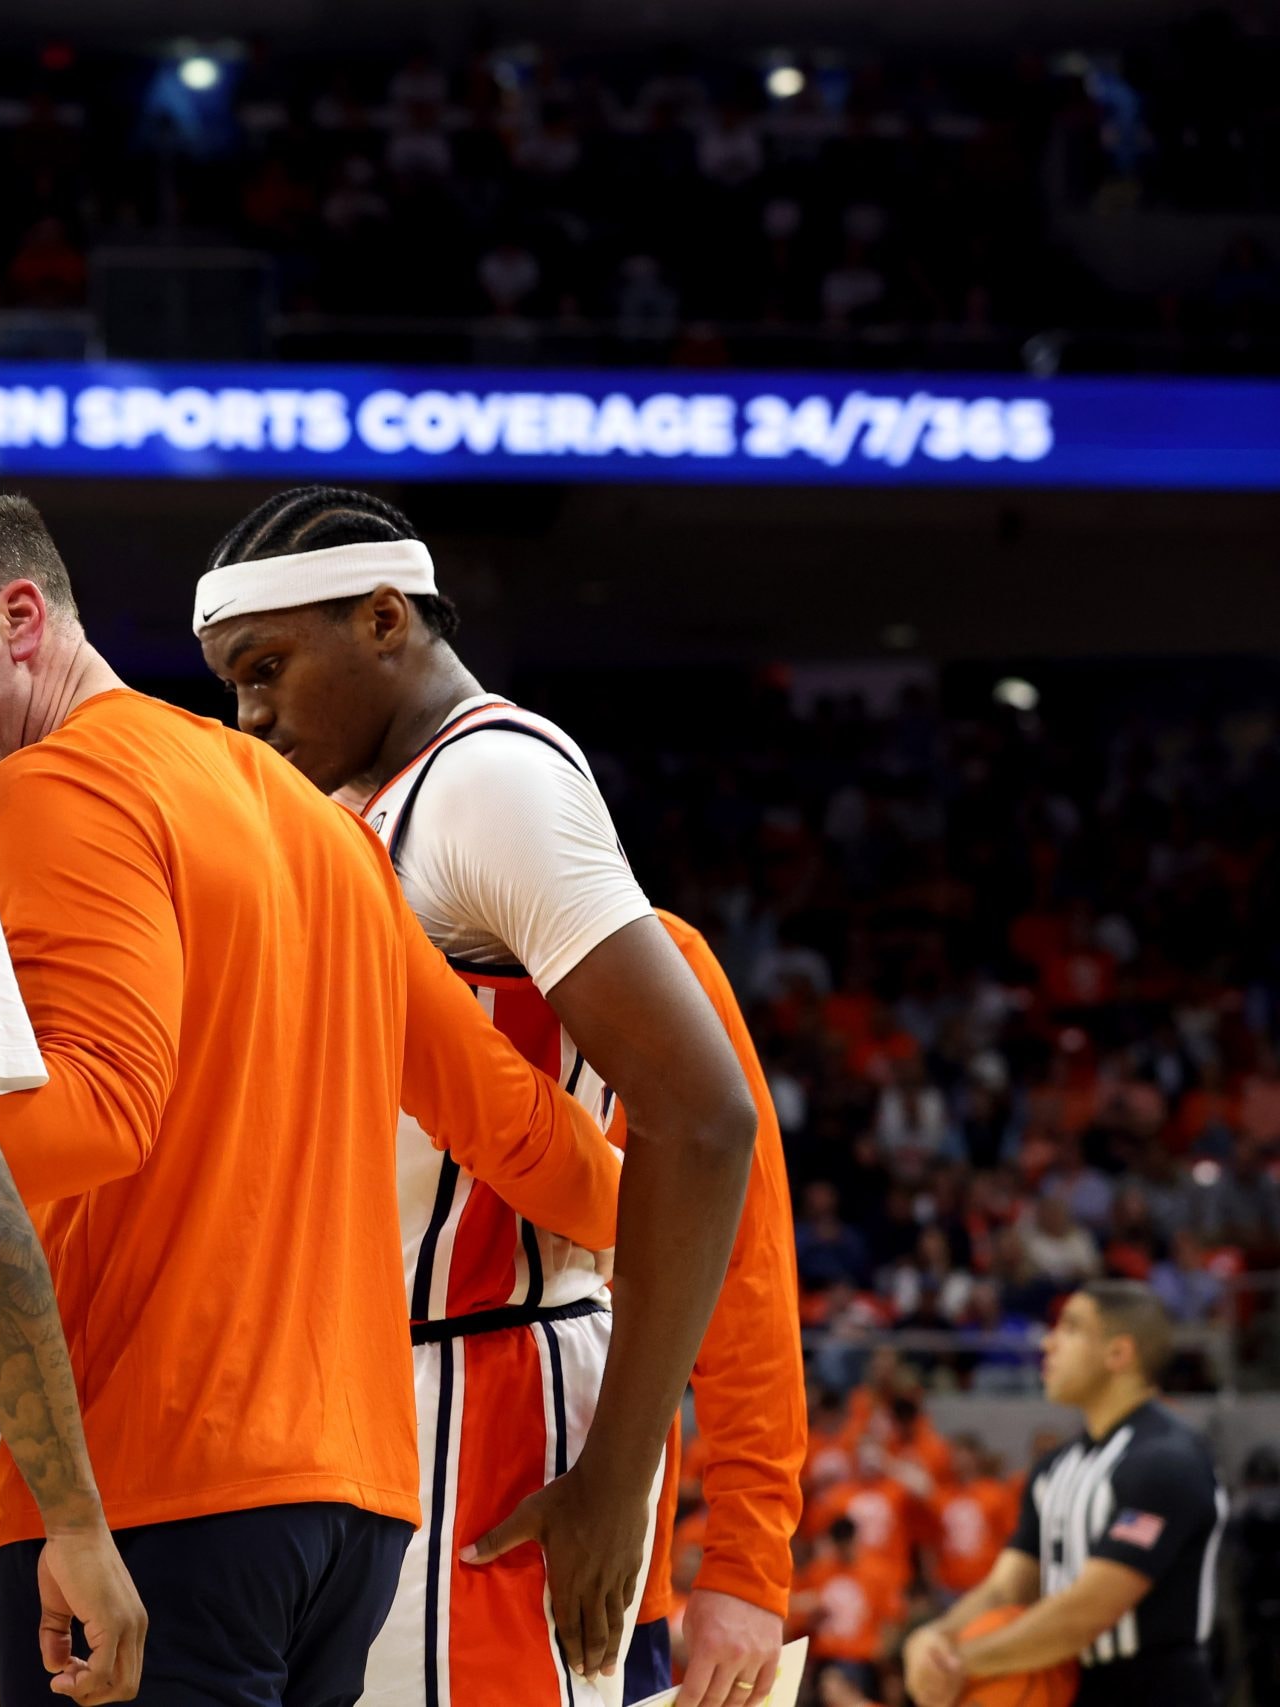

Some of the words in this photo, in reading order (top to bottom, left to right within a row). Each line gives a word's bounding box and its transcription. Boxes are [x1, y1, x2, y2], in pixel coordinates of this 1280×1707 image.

[73, 385, 352, 453] SPORTS
[356, 389, 738, 456] COVERAGE
[743, 390, 1054, 467] 24/7/365
